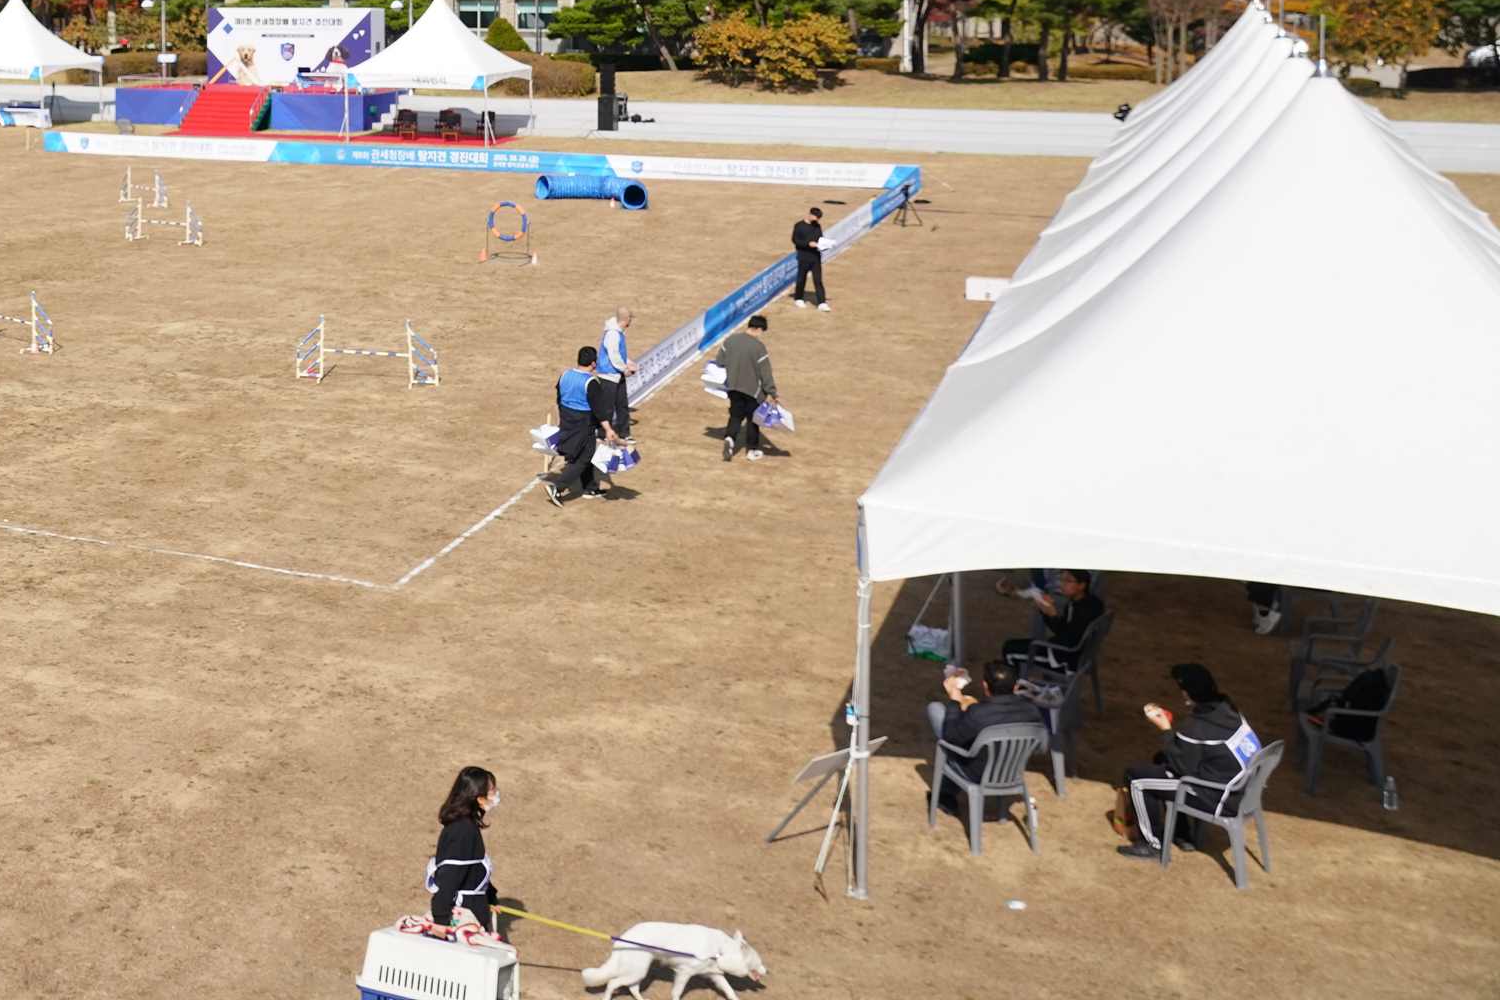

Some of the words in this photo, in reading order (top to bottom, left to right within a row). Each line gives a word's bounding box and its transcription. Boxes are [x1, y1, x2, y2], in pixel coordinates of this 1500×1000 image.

[371, 149, 415, 162] 관세청장배
[418, 150, 445, 163] 탐지견
[449, 151, 488, 164] 경진대회
